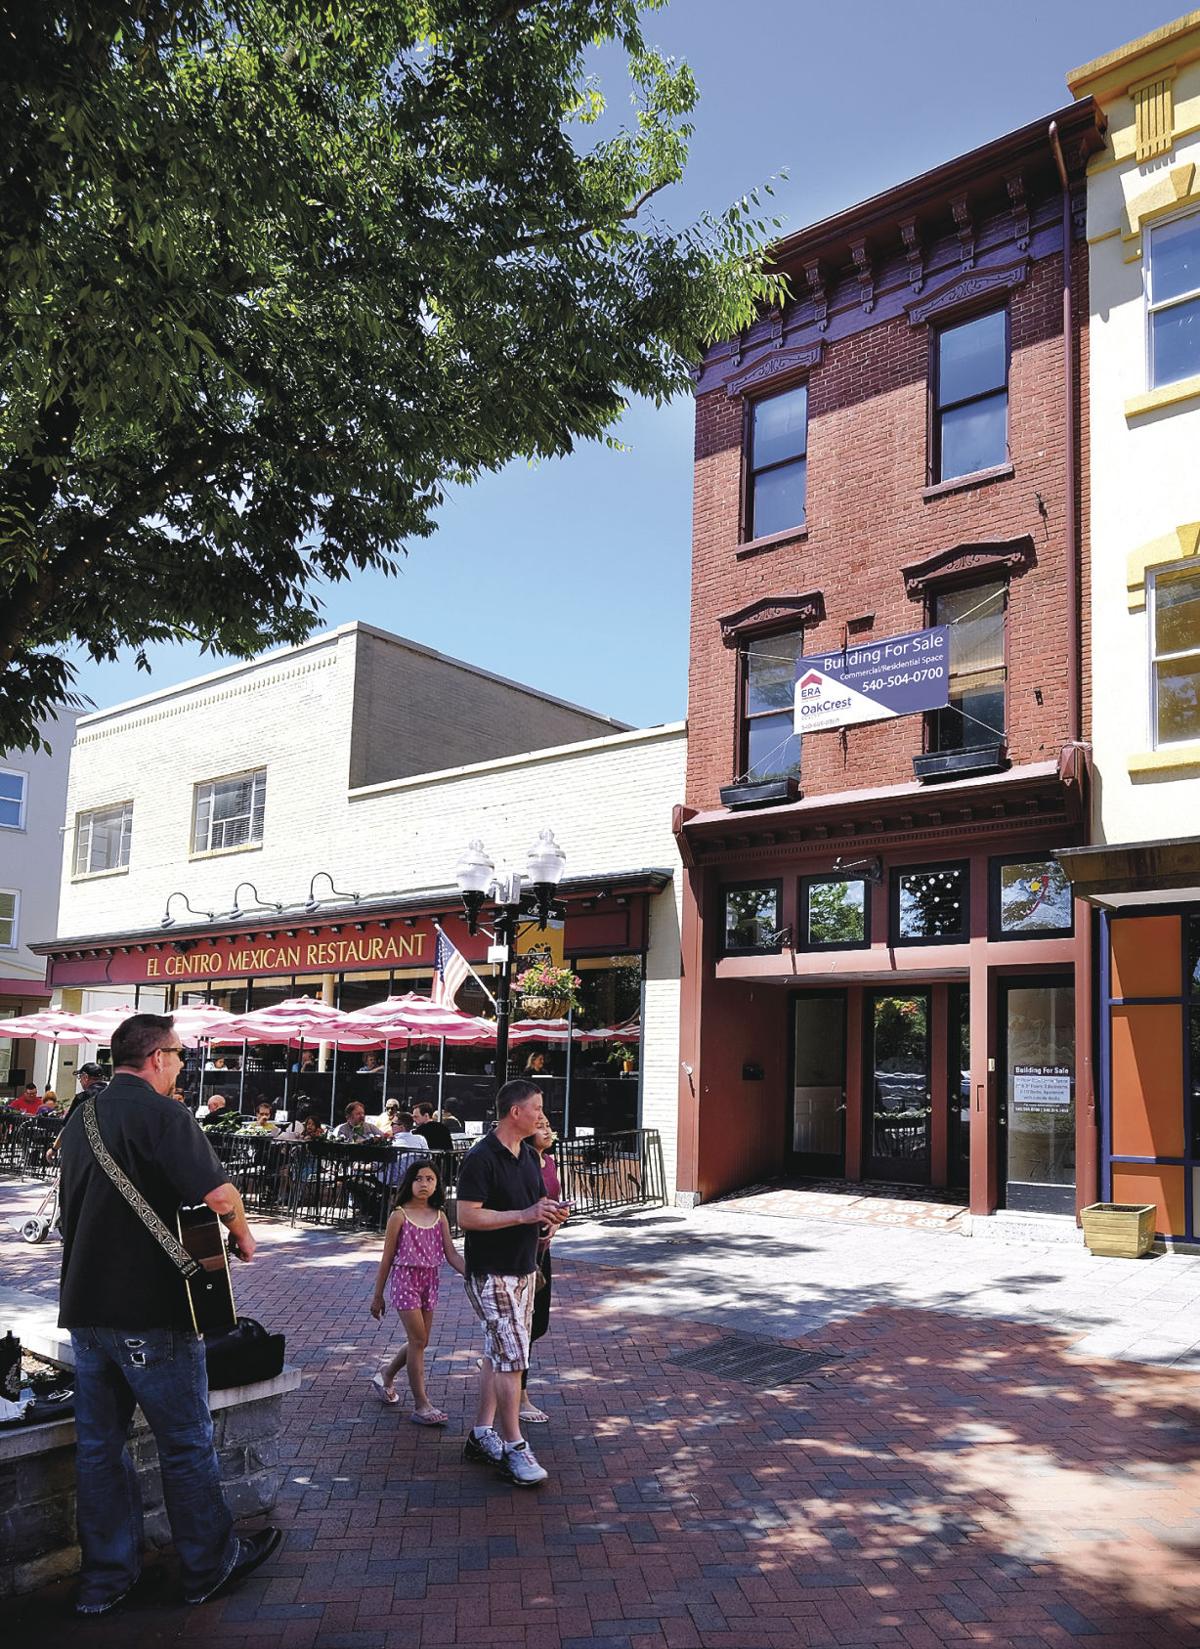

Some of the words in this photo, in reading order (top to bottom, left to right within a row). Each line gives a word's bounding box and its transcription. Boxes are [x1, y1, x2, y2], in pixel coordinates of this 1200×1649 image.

[824, 650, 880, 672] Building
[885, 643, 908, 658] For
[913, 634, 944, 652] Sale
[840, 658, 920, 681] Commercial/Residential
[921, 654, 944, 665] Space
[862, 667, 944, 693] 540-504-0700
[801, 687, 821, 698] ERA
[801, 697, 852, 715] OakCrest
[147, 958, 161, 977] EL
[165, 952, 221, 976] CENTRO
[227, 946, 300, 972] MEXICAN
[306, 933, 427, 965] RESTAURANT
[1015, 1066, 1042, 1075] Building
[1043, 1066, 1053, 1074] For
[1054, 1066, 1069, 1074] Sale
